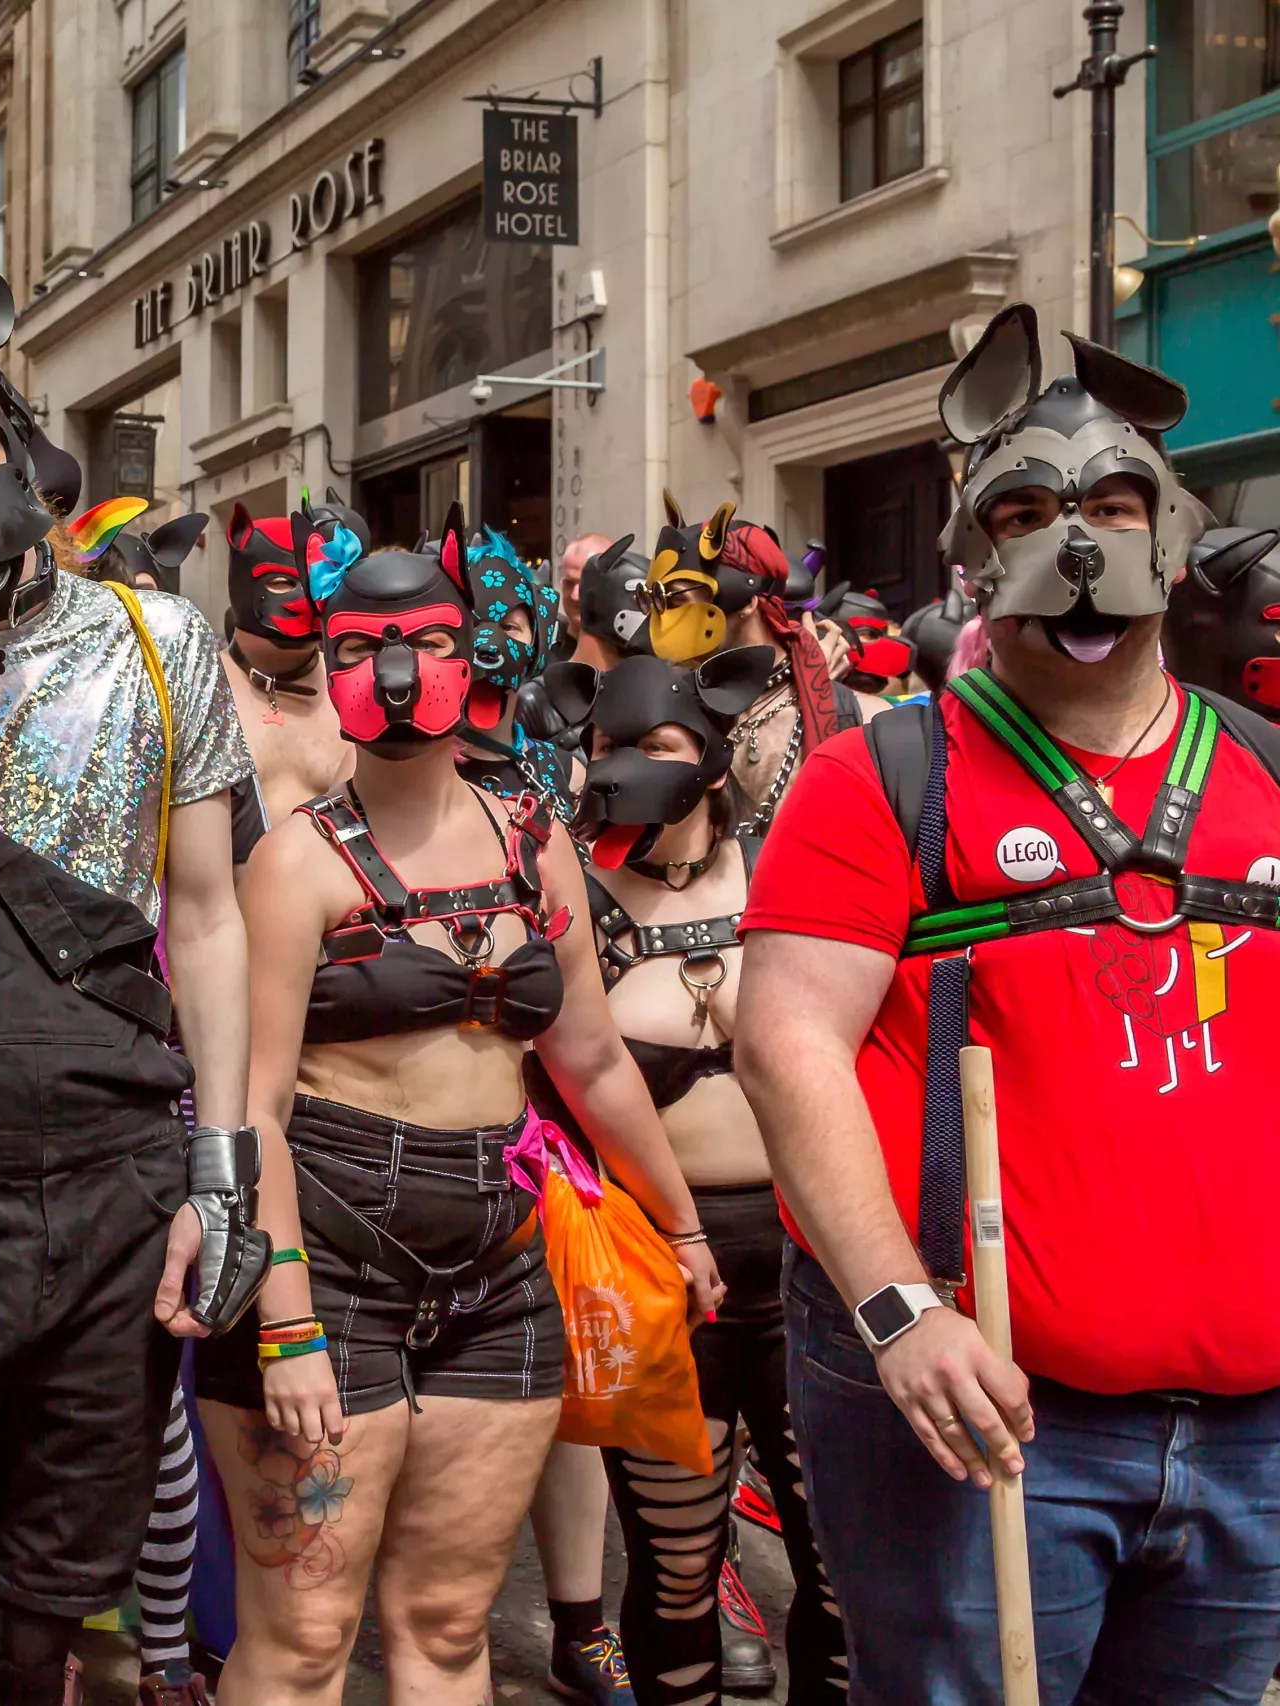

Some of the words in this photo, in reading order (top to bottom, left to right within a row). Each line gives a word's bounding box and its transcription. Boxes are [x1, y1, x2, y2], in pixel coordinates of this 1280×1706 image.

[511, 118, 550, 143] THE
[500, 149, 562, 175] BRIAR
[503, 180, 559, 205] ROSE
[496, 212, 568, 238] HOTEL
[131, 282, 173, 349] THE
[186, 221, 270, 317] BRIAR
[289, 138, 385, 252] ROSE
[1002, 840, 1055, 864] LEGO!
